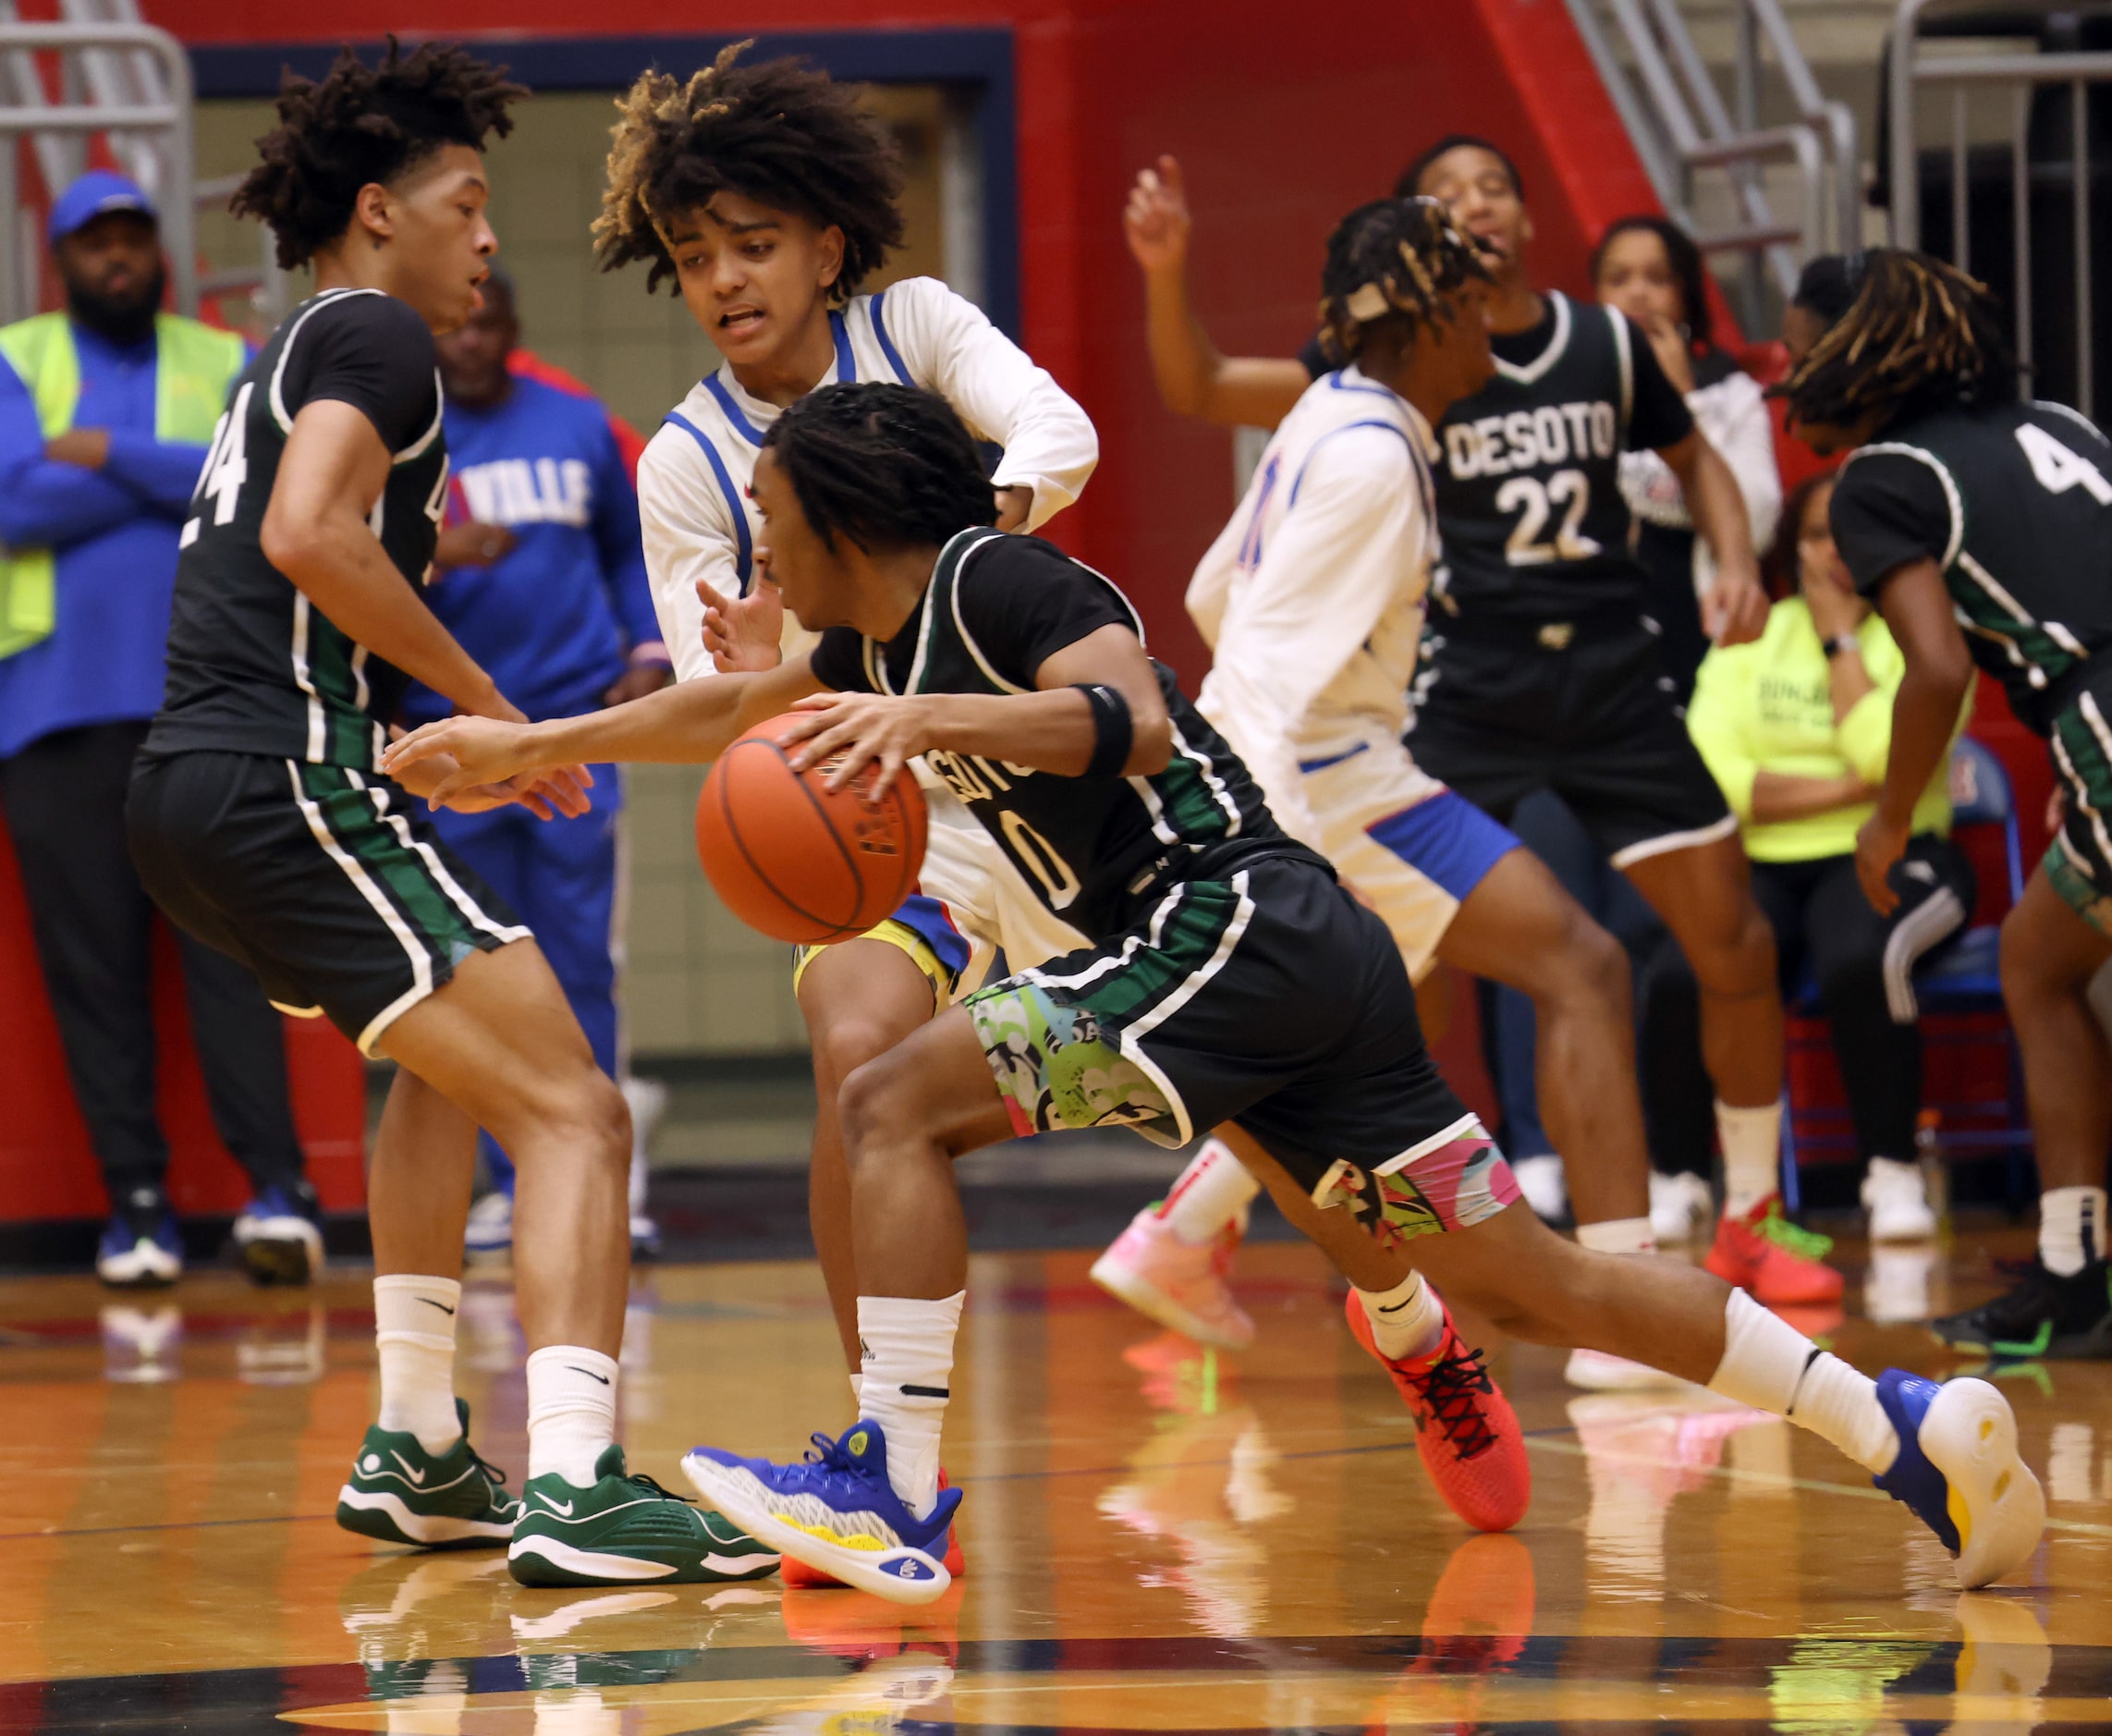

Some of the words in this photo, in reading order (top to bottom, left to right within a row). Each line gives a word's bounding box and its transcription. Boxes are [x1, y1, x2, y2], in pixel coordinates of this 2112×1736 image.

[1446, 400, 1617, 482] DESOTO
[2014, 422, 2112, 507] 4
[1495, 469, 1602, 567] 22
[998, 809, 1083, 911] 0
